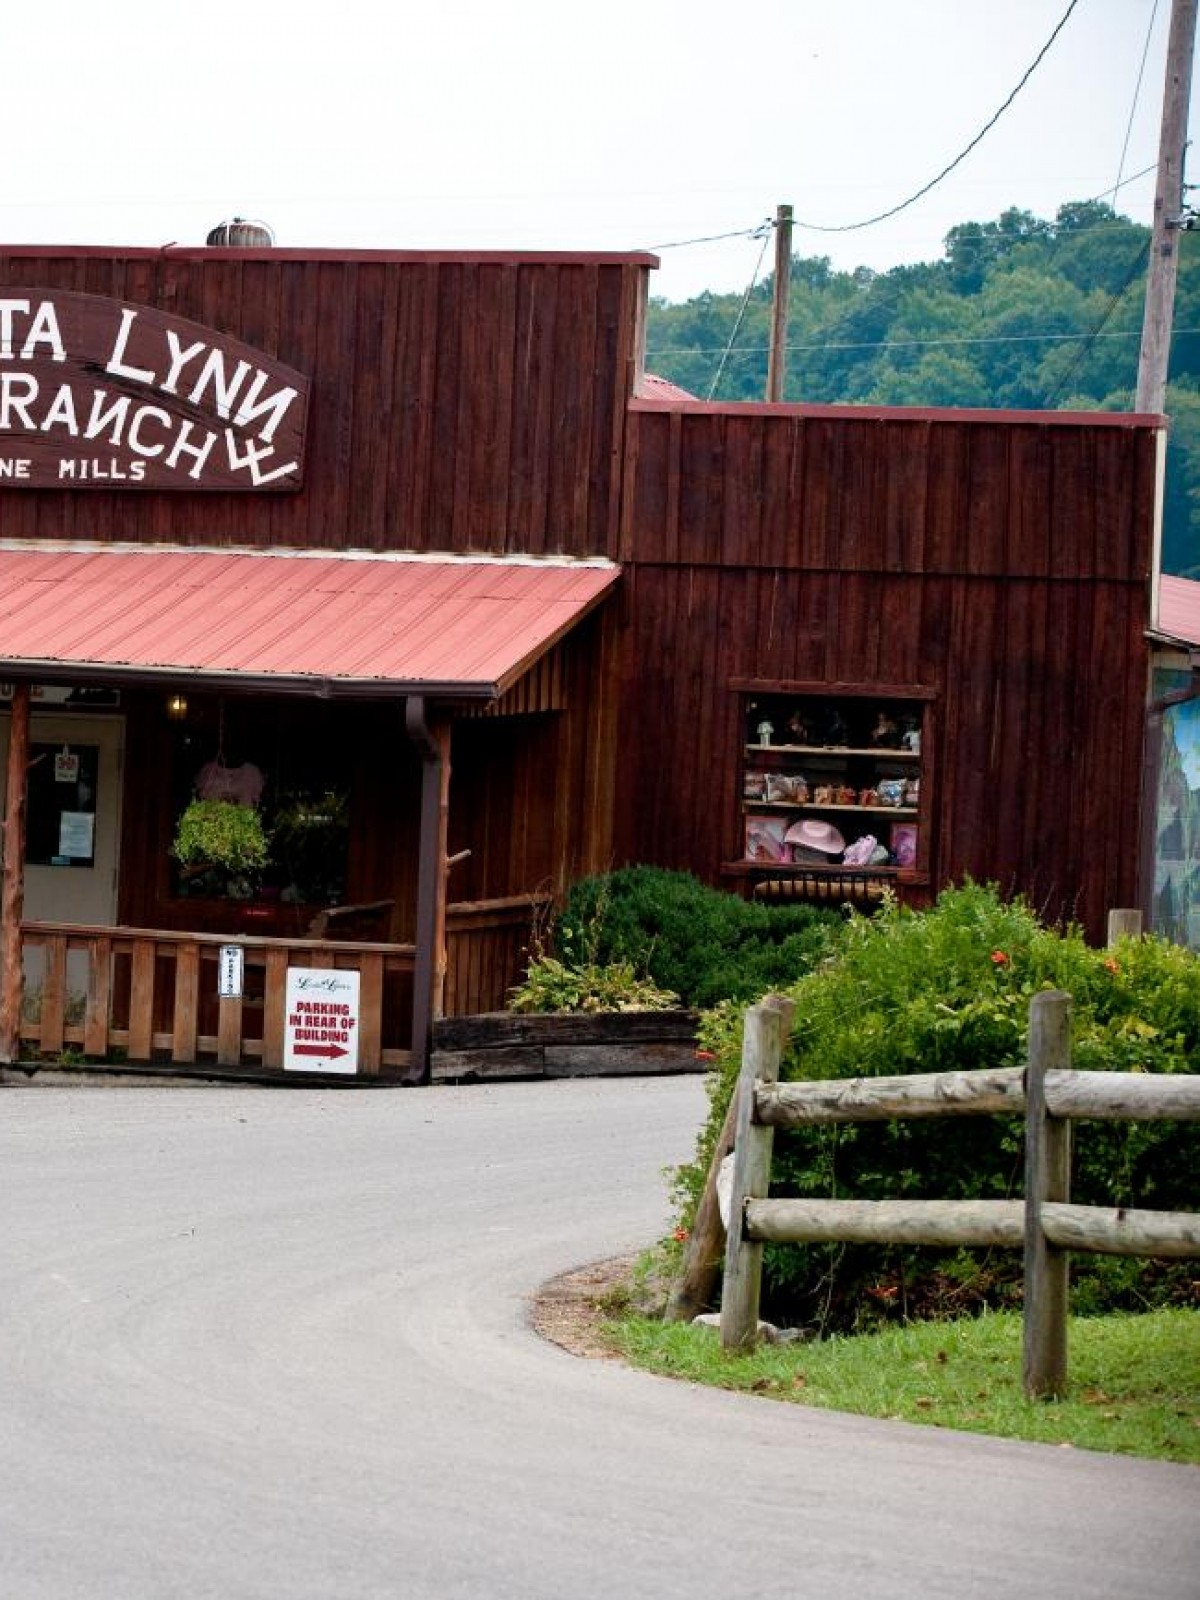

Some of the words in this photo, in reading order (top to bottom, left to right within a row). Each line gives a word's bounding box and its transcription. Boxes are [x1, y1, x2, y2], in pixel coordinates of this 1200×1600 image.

[106, 308, 298, 443] LYNN
[58, 457, 146, 480] MILLS
[296, 1001, 350, 1016] PARKING
[290, 1014, 301, 1026] IN
[305, 1015, 337, 1028] REAR
[341, 1018, 356, 1029] OF
[295, 1028, 349, 1043] BUILDING
